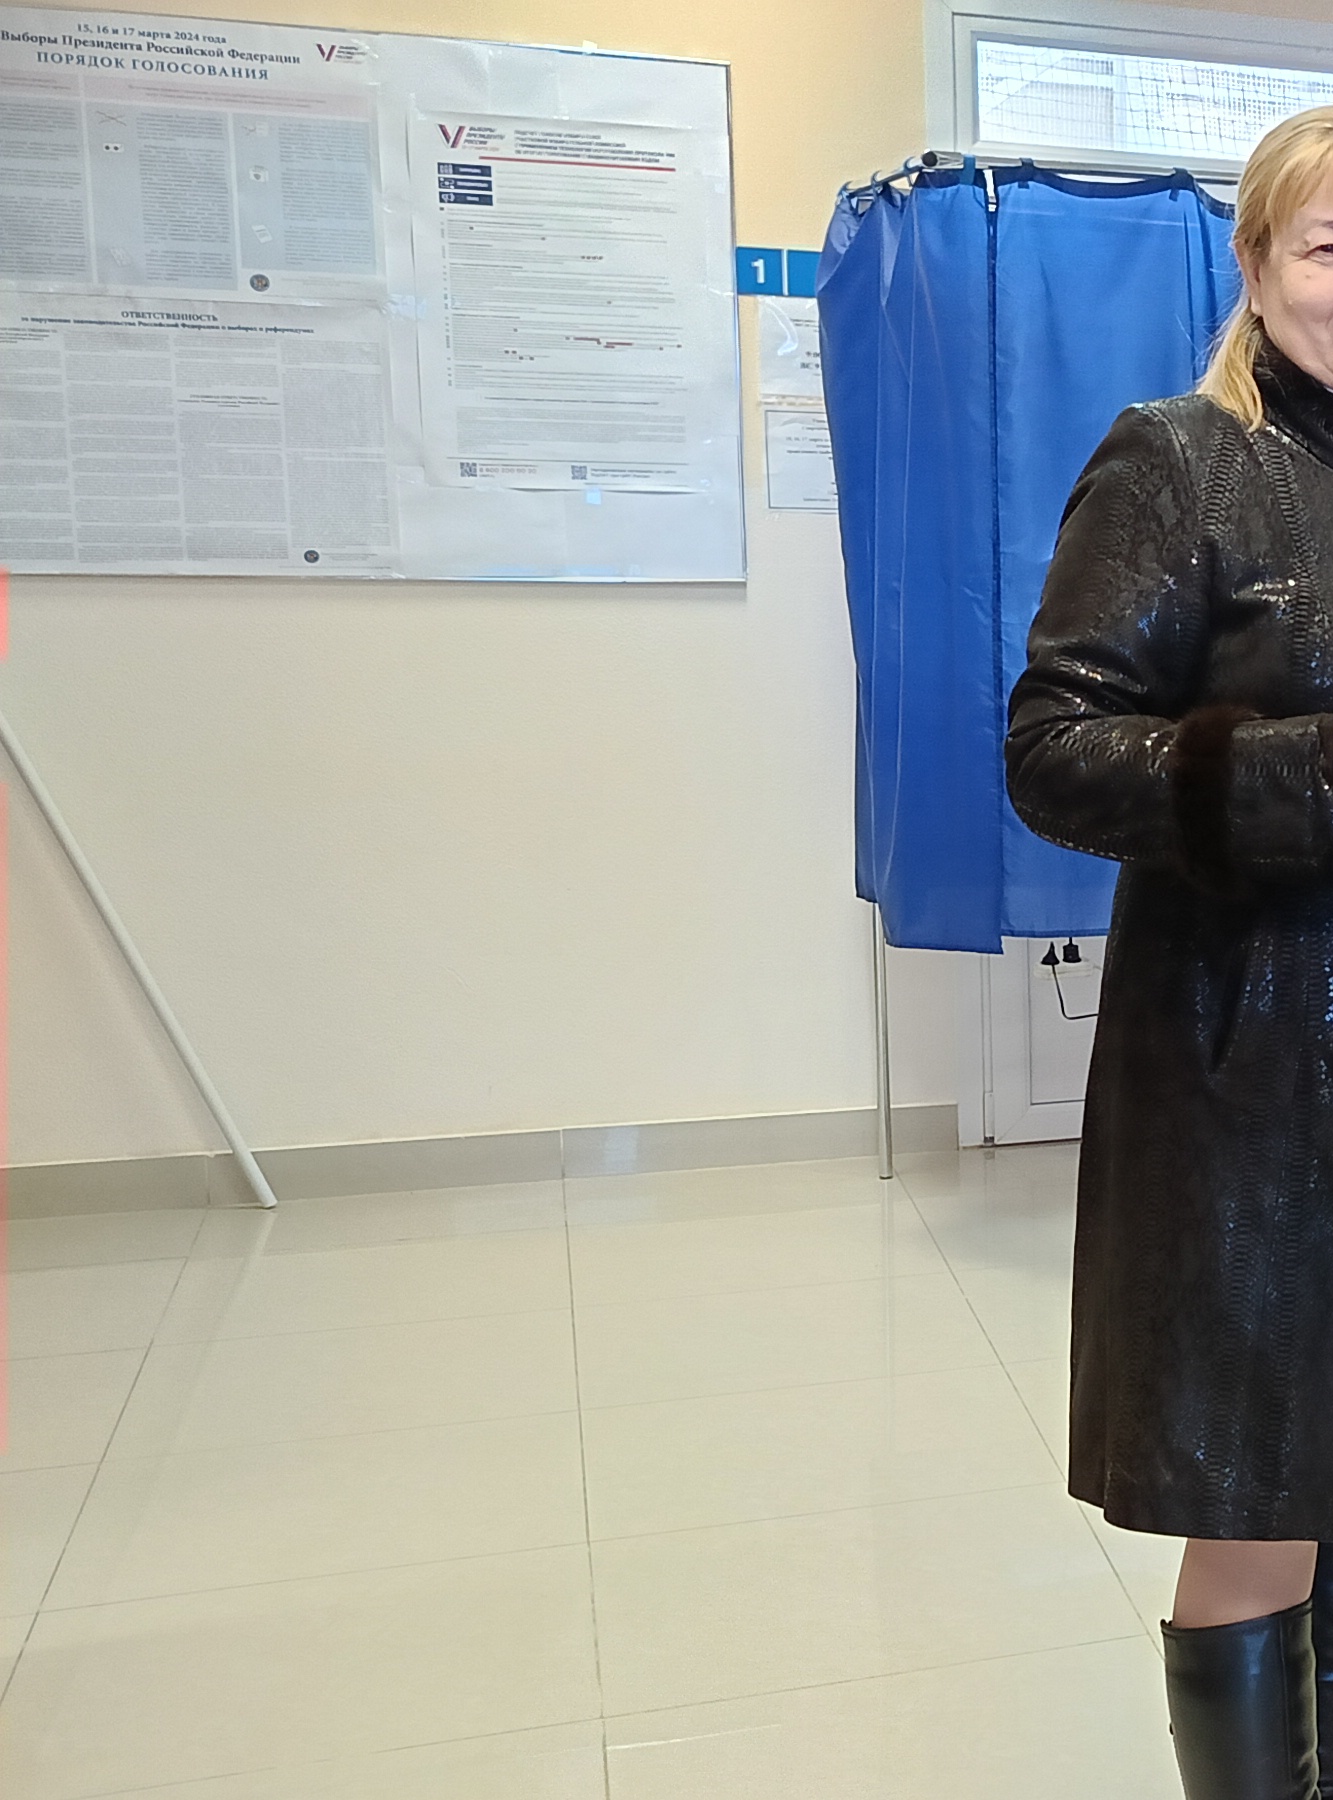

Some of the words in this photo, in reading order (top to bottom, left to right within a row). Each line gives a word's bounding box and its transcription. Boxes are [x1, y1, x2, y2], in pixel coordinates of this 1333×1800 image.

[1, 30, 58, 46] Выборы
[62, 34, 143, 51] Президента
[146, 41, 224, 58] Российской
[227, 48, 301, 64] Федерации
[97, 25, 109, 35] 16
[123, 27, 135, 36] 17
[138, 29, 170, 40] марта
[174, 31, 199, 41] 2024
[202, 35, 227, 44] года
[37, 51, 126, 69] ПОРЯДОК
[131, 58, 270, 80] ГОЛОСОВАНИЯ
[751, 258, 766, 285] 1
[121, 310, 219, 322] ОТВЕТСТВЕННОСТЬ
